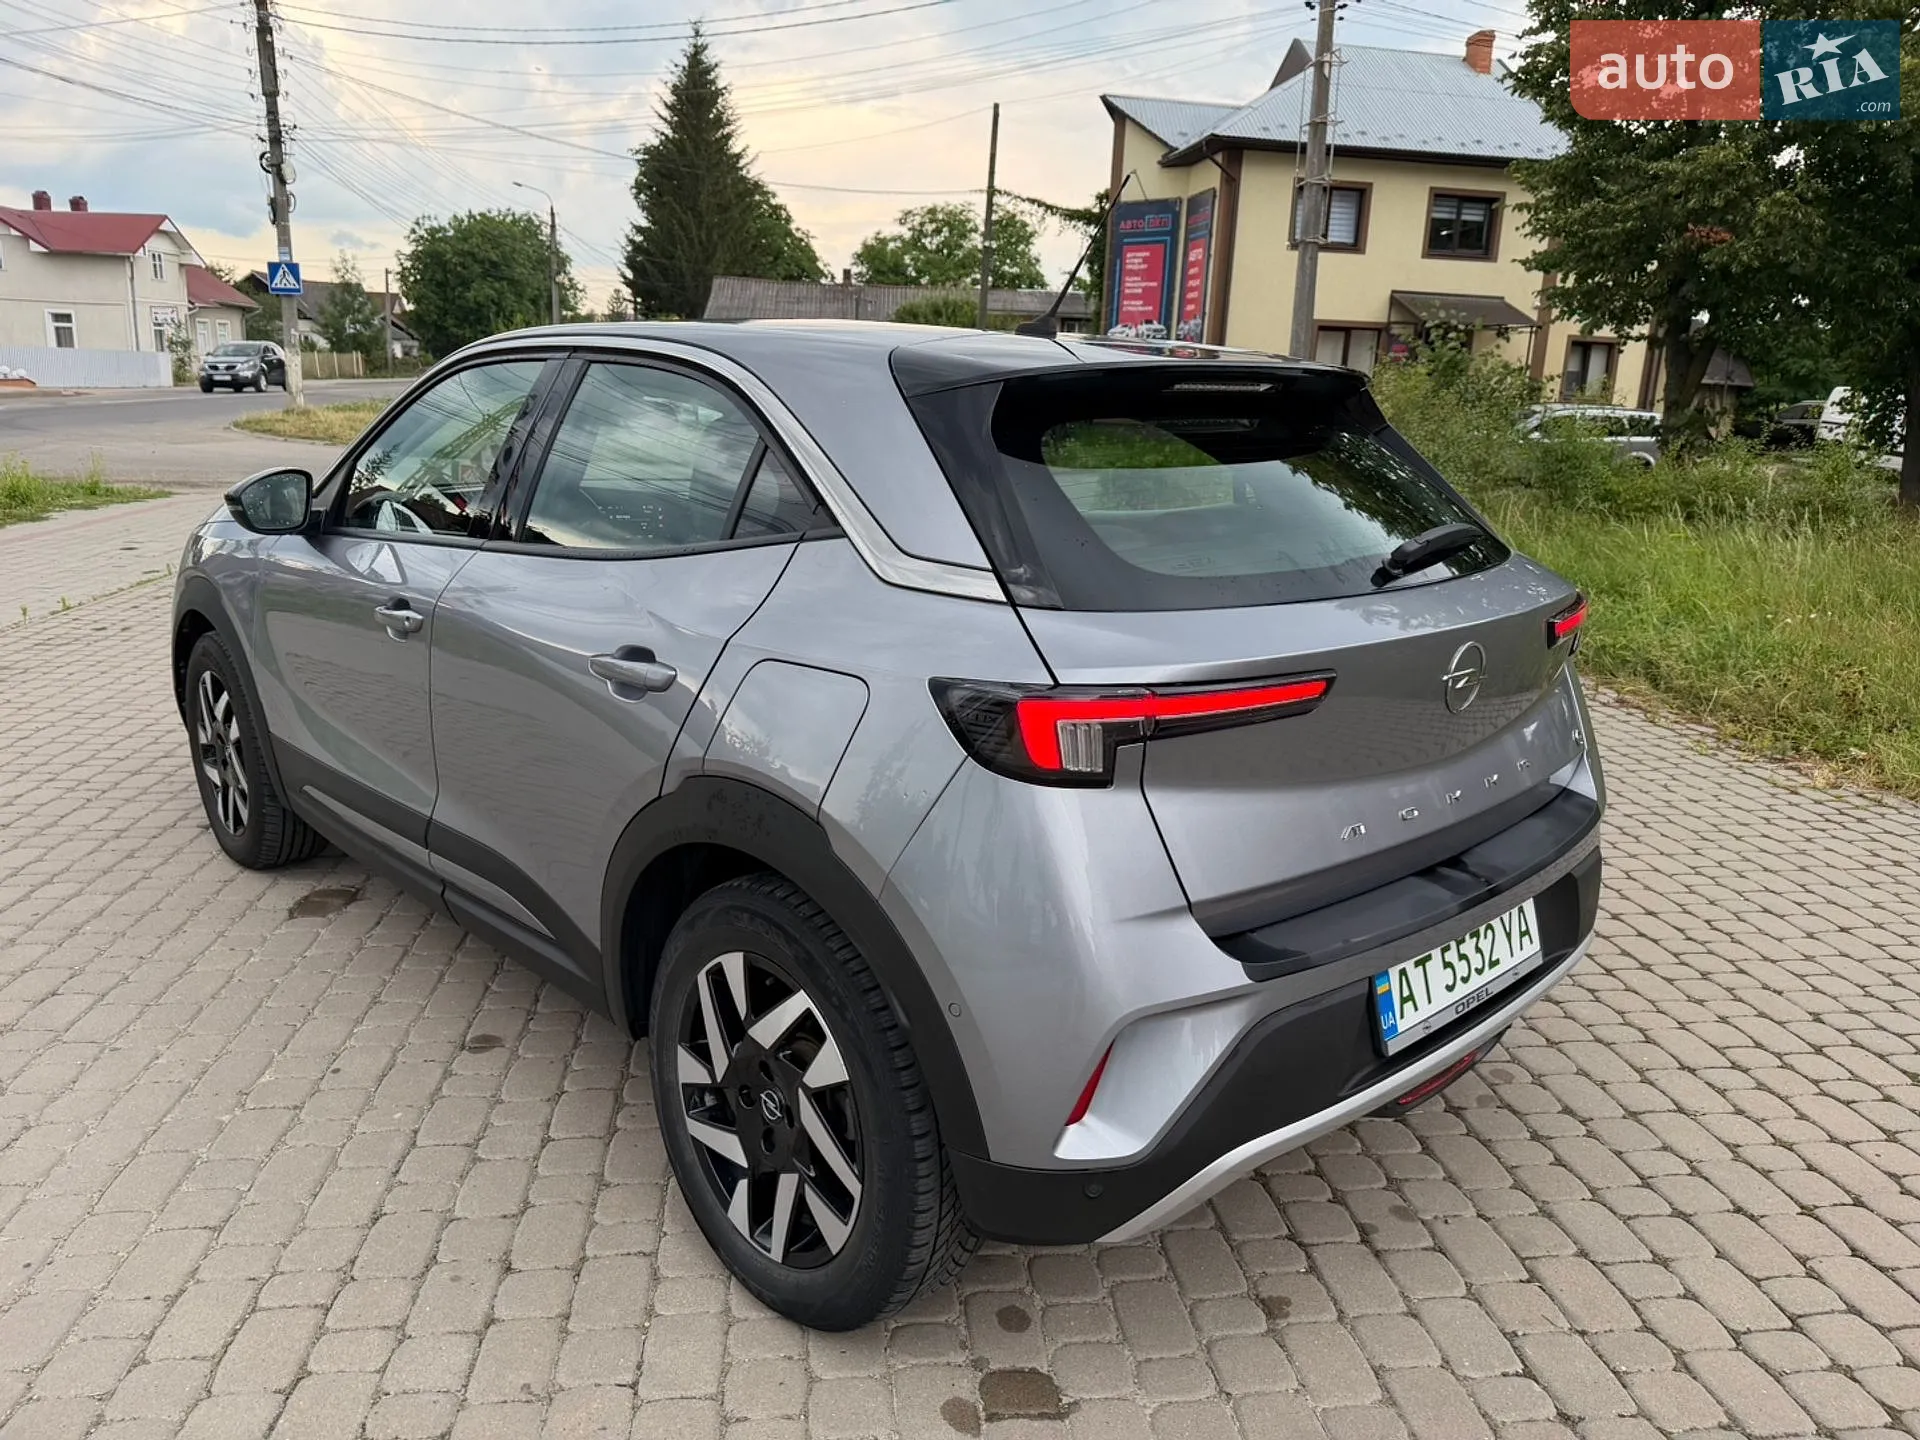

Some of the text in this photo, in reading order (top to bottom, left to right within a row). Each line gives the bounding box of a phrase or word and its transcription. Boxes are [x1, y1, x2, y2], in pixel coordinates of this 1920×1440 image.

[1398, 905, 1533, 1020] AT 5532 YA
[1454, 987, 1494, 1015] OPEL
[1381, 1012, 1396, 1030] UA
